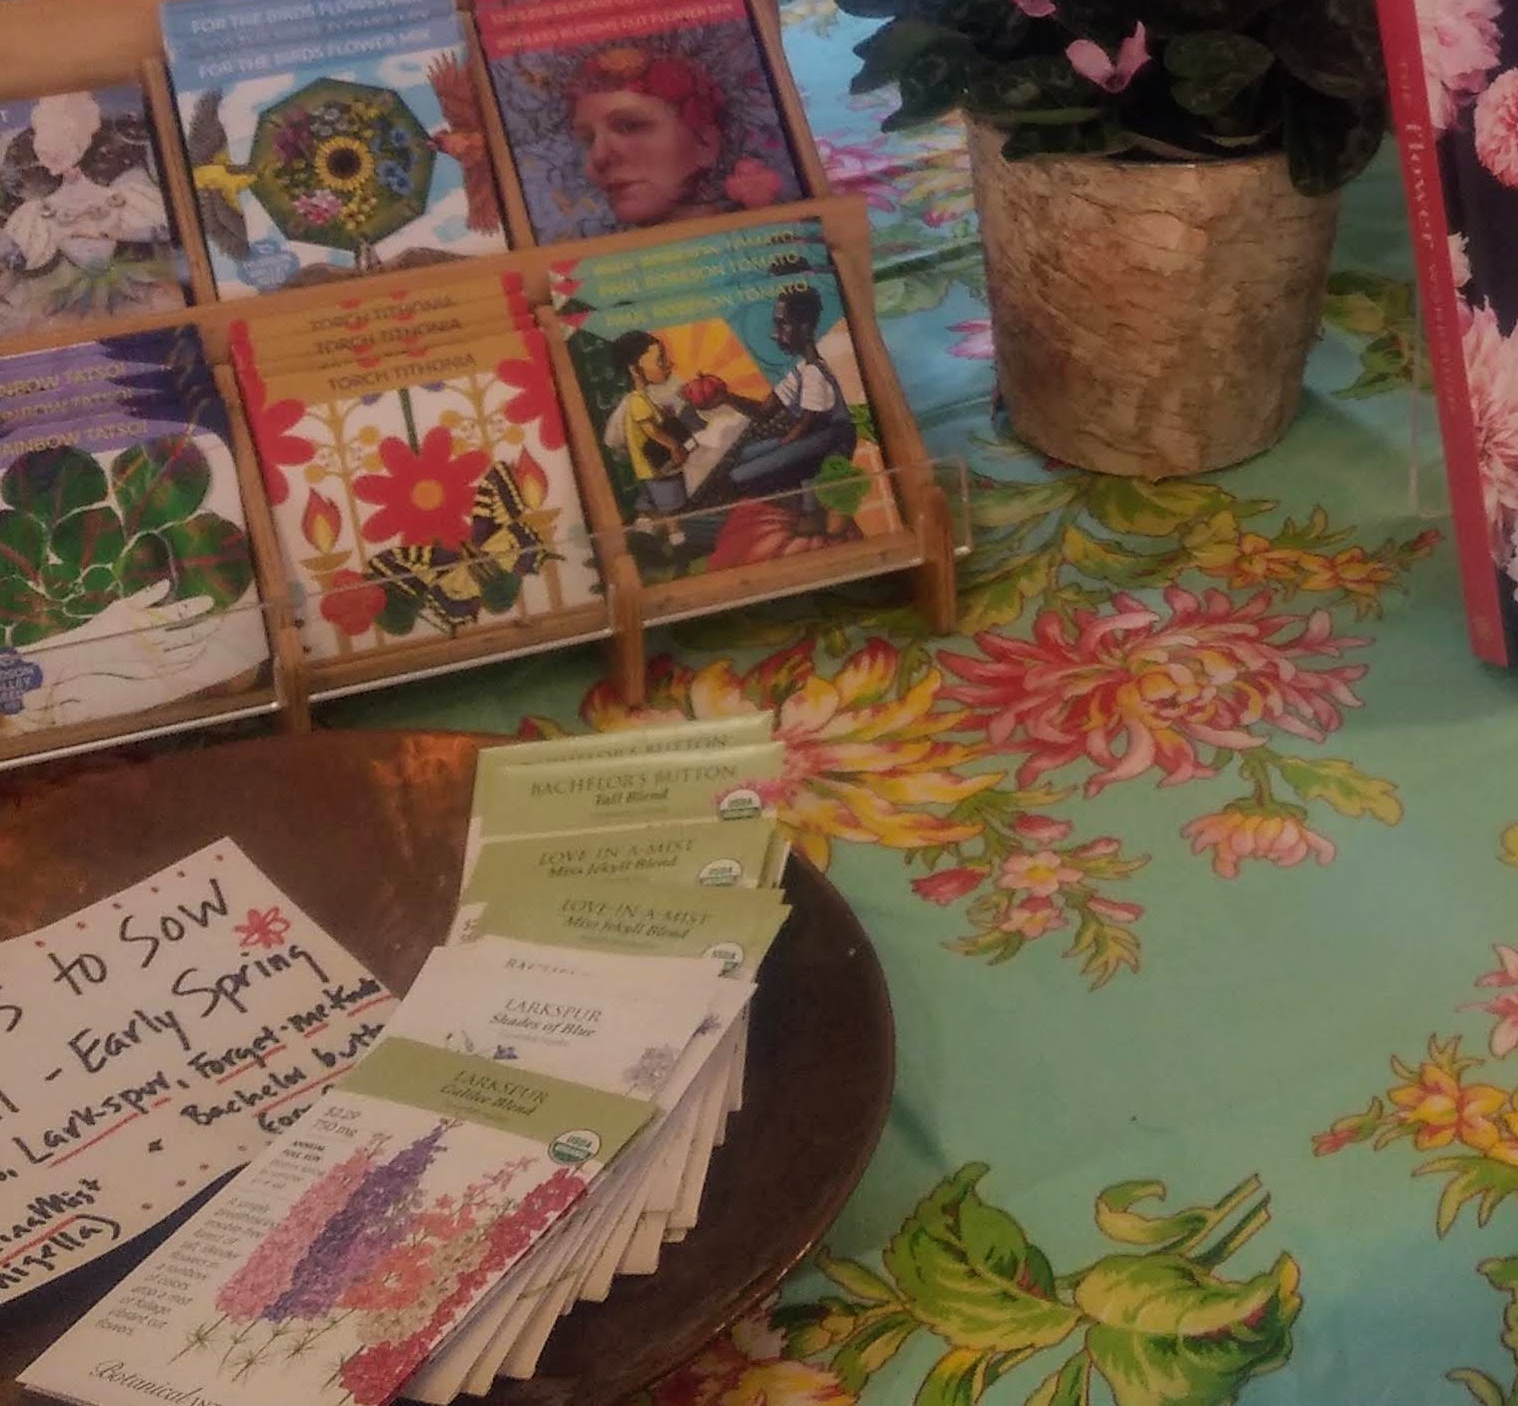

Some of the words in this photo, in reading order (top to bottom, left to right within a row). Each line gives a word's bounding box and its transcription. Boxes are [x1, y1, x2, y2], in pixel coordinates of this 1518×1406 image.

[191, 17, 227, 35] FOR
[199, 63, 234, 80] FOR
[730, 251, 800, 274] TOMATO
[310, 313, 370, 332] TORCH
[316, 334, 375, 355] TORCH
[328, 370, 391, 391] TORCH
[394, 353, 476, 380] TITHONIA
[655, 764, 738, 785] BUTTON
[635, 855, 679, 871] Blend
[646, 923, 690, 938] Blend
[48, 953, 107, 995] to
[68, 1010, 191, 1074] Early
[172, 945, 329, 1018] Spring
[504, 998, 602, 1023] LARKSPUR
[489, 1013, 541, 1030] Shades
[543, 1020, 559, 1035] of
[562, 1022, 596, 1037] Blue
[454, 1070, 550, 1104] LARKSPUR
[88, 1358, 204, 1405] Botanical
